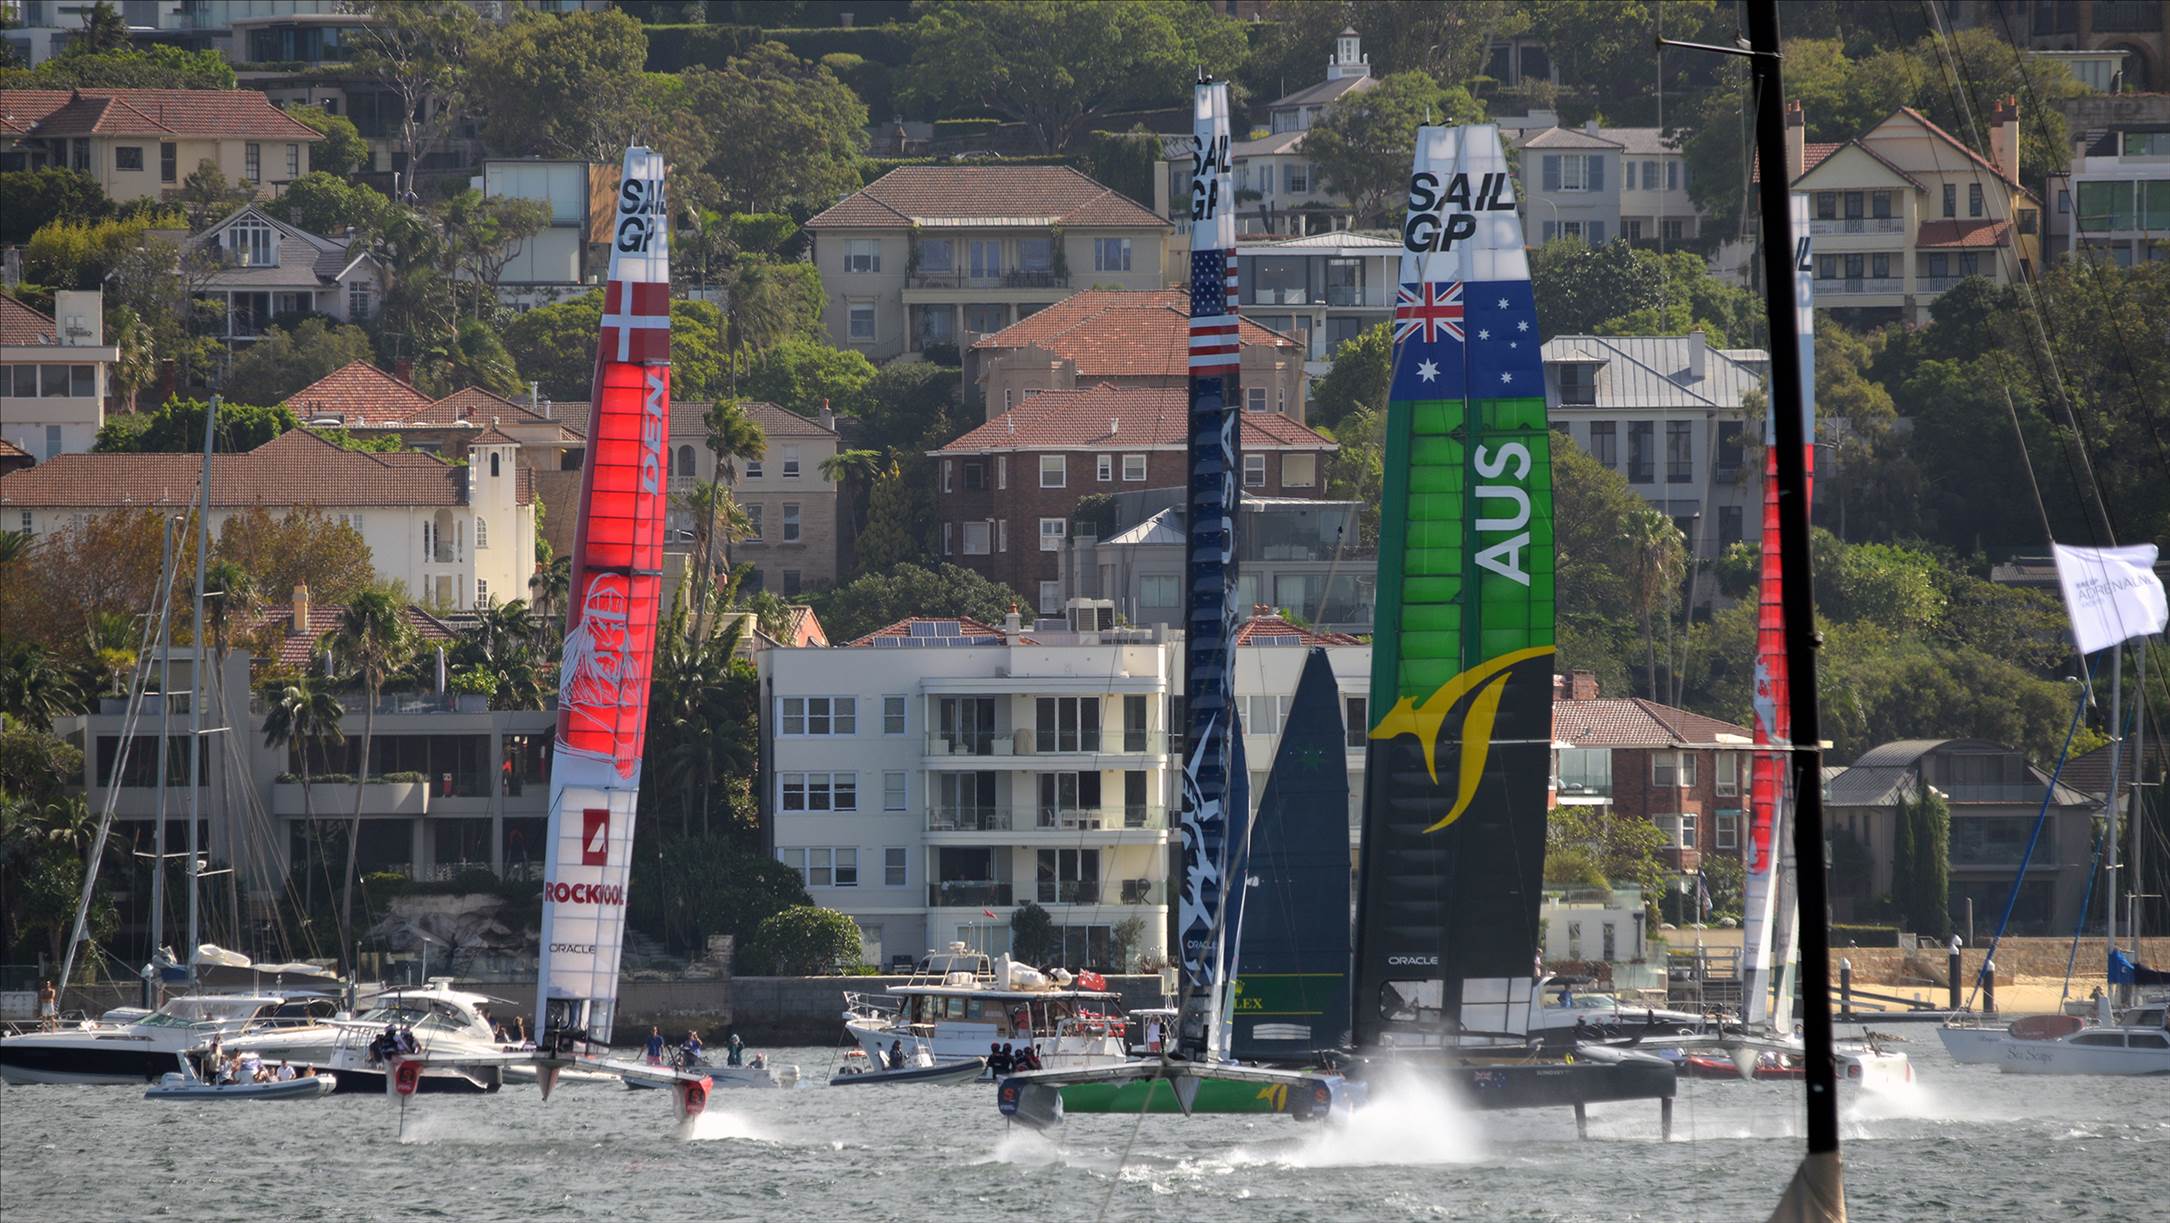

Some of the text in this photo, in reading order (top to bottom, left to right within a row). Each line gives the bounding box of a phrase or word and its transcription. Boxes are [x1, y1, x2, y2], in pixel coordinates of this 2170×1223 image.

[620, 179, 667, 214] SAIL
[1408, 172, 1516, 212] SAIL
[618, 217, 655, 252] GP
[1404, 213, 1477, 253] GP
[643, 374, 664, 497] DEN
[1474, 442, 1532, 587] AUS
[549, 943, 596, 954] ORACLE
[1388, 956, 1439, 965] ORACLE
[1233, 998, 1263, 1009] LEX
